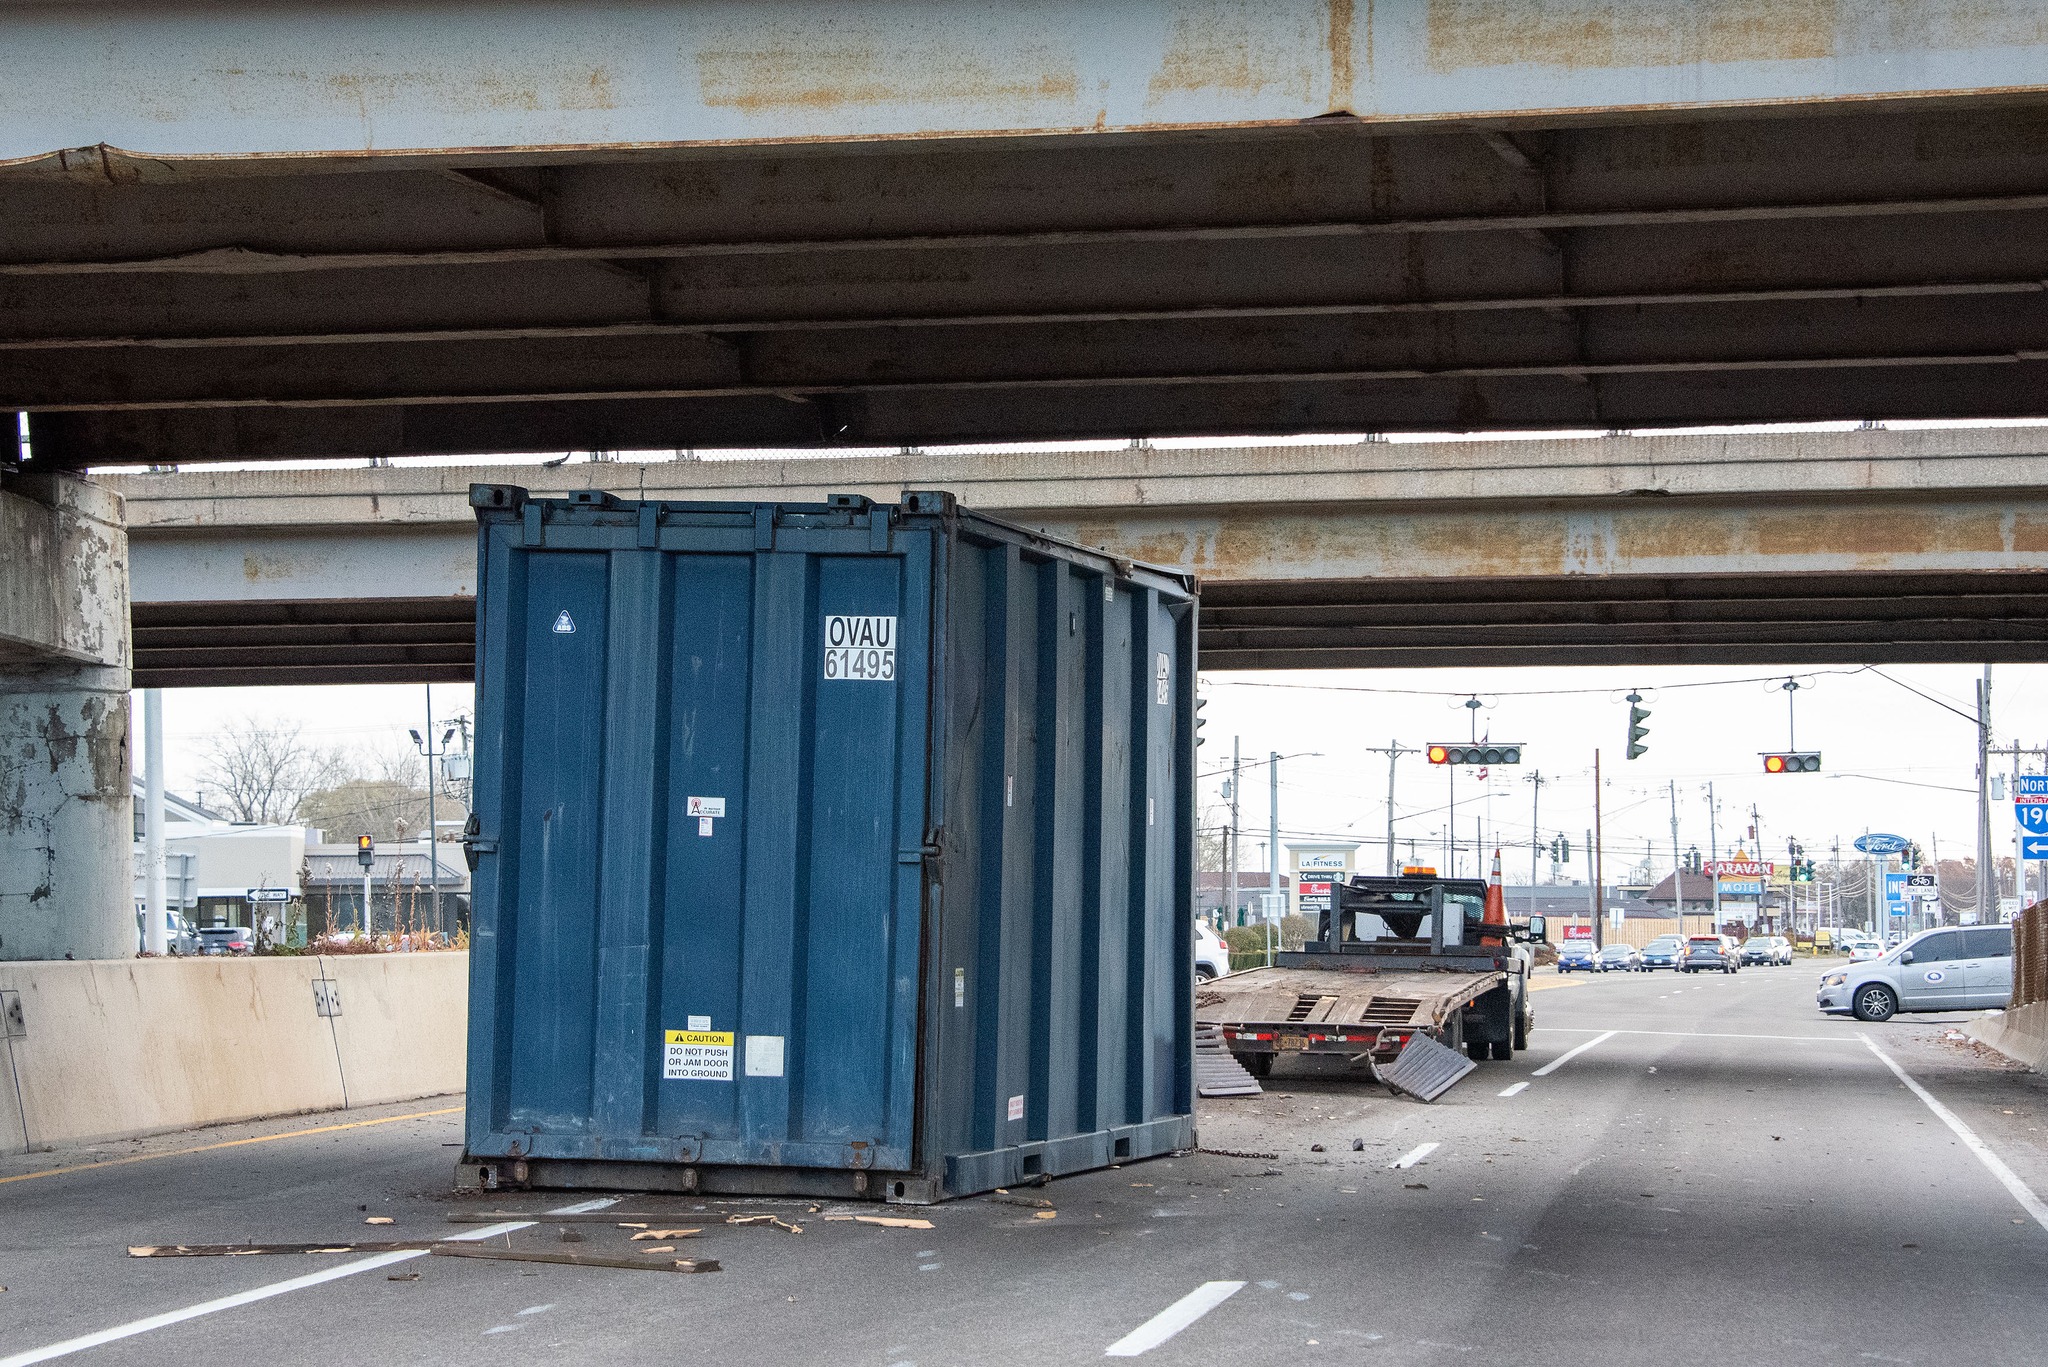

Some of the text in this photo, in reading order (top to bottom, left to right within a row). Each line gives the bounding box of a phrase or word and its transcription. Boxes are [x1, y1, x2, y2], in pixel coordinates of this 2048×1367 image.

[829, 616, 890, 648] OVAU
[825, 649, 894, 680] 61495
[1865, 837, 1898, 851] Ford
[686, 1034, 725, 1043] CAUTION
[670, 1047, 728, 1057] DO NOT PUSH
[668, 1058, 729, 1067] OR JAM DOOR
[668, 1069, 728, 1078] INTO GROUND
